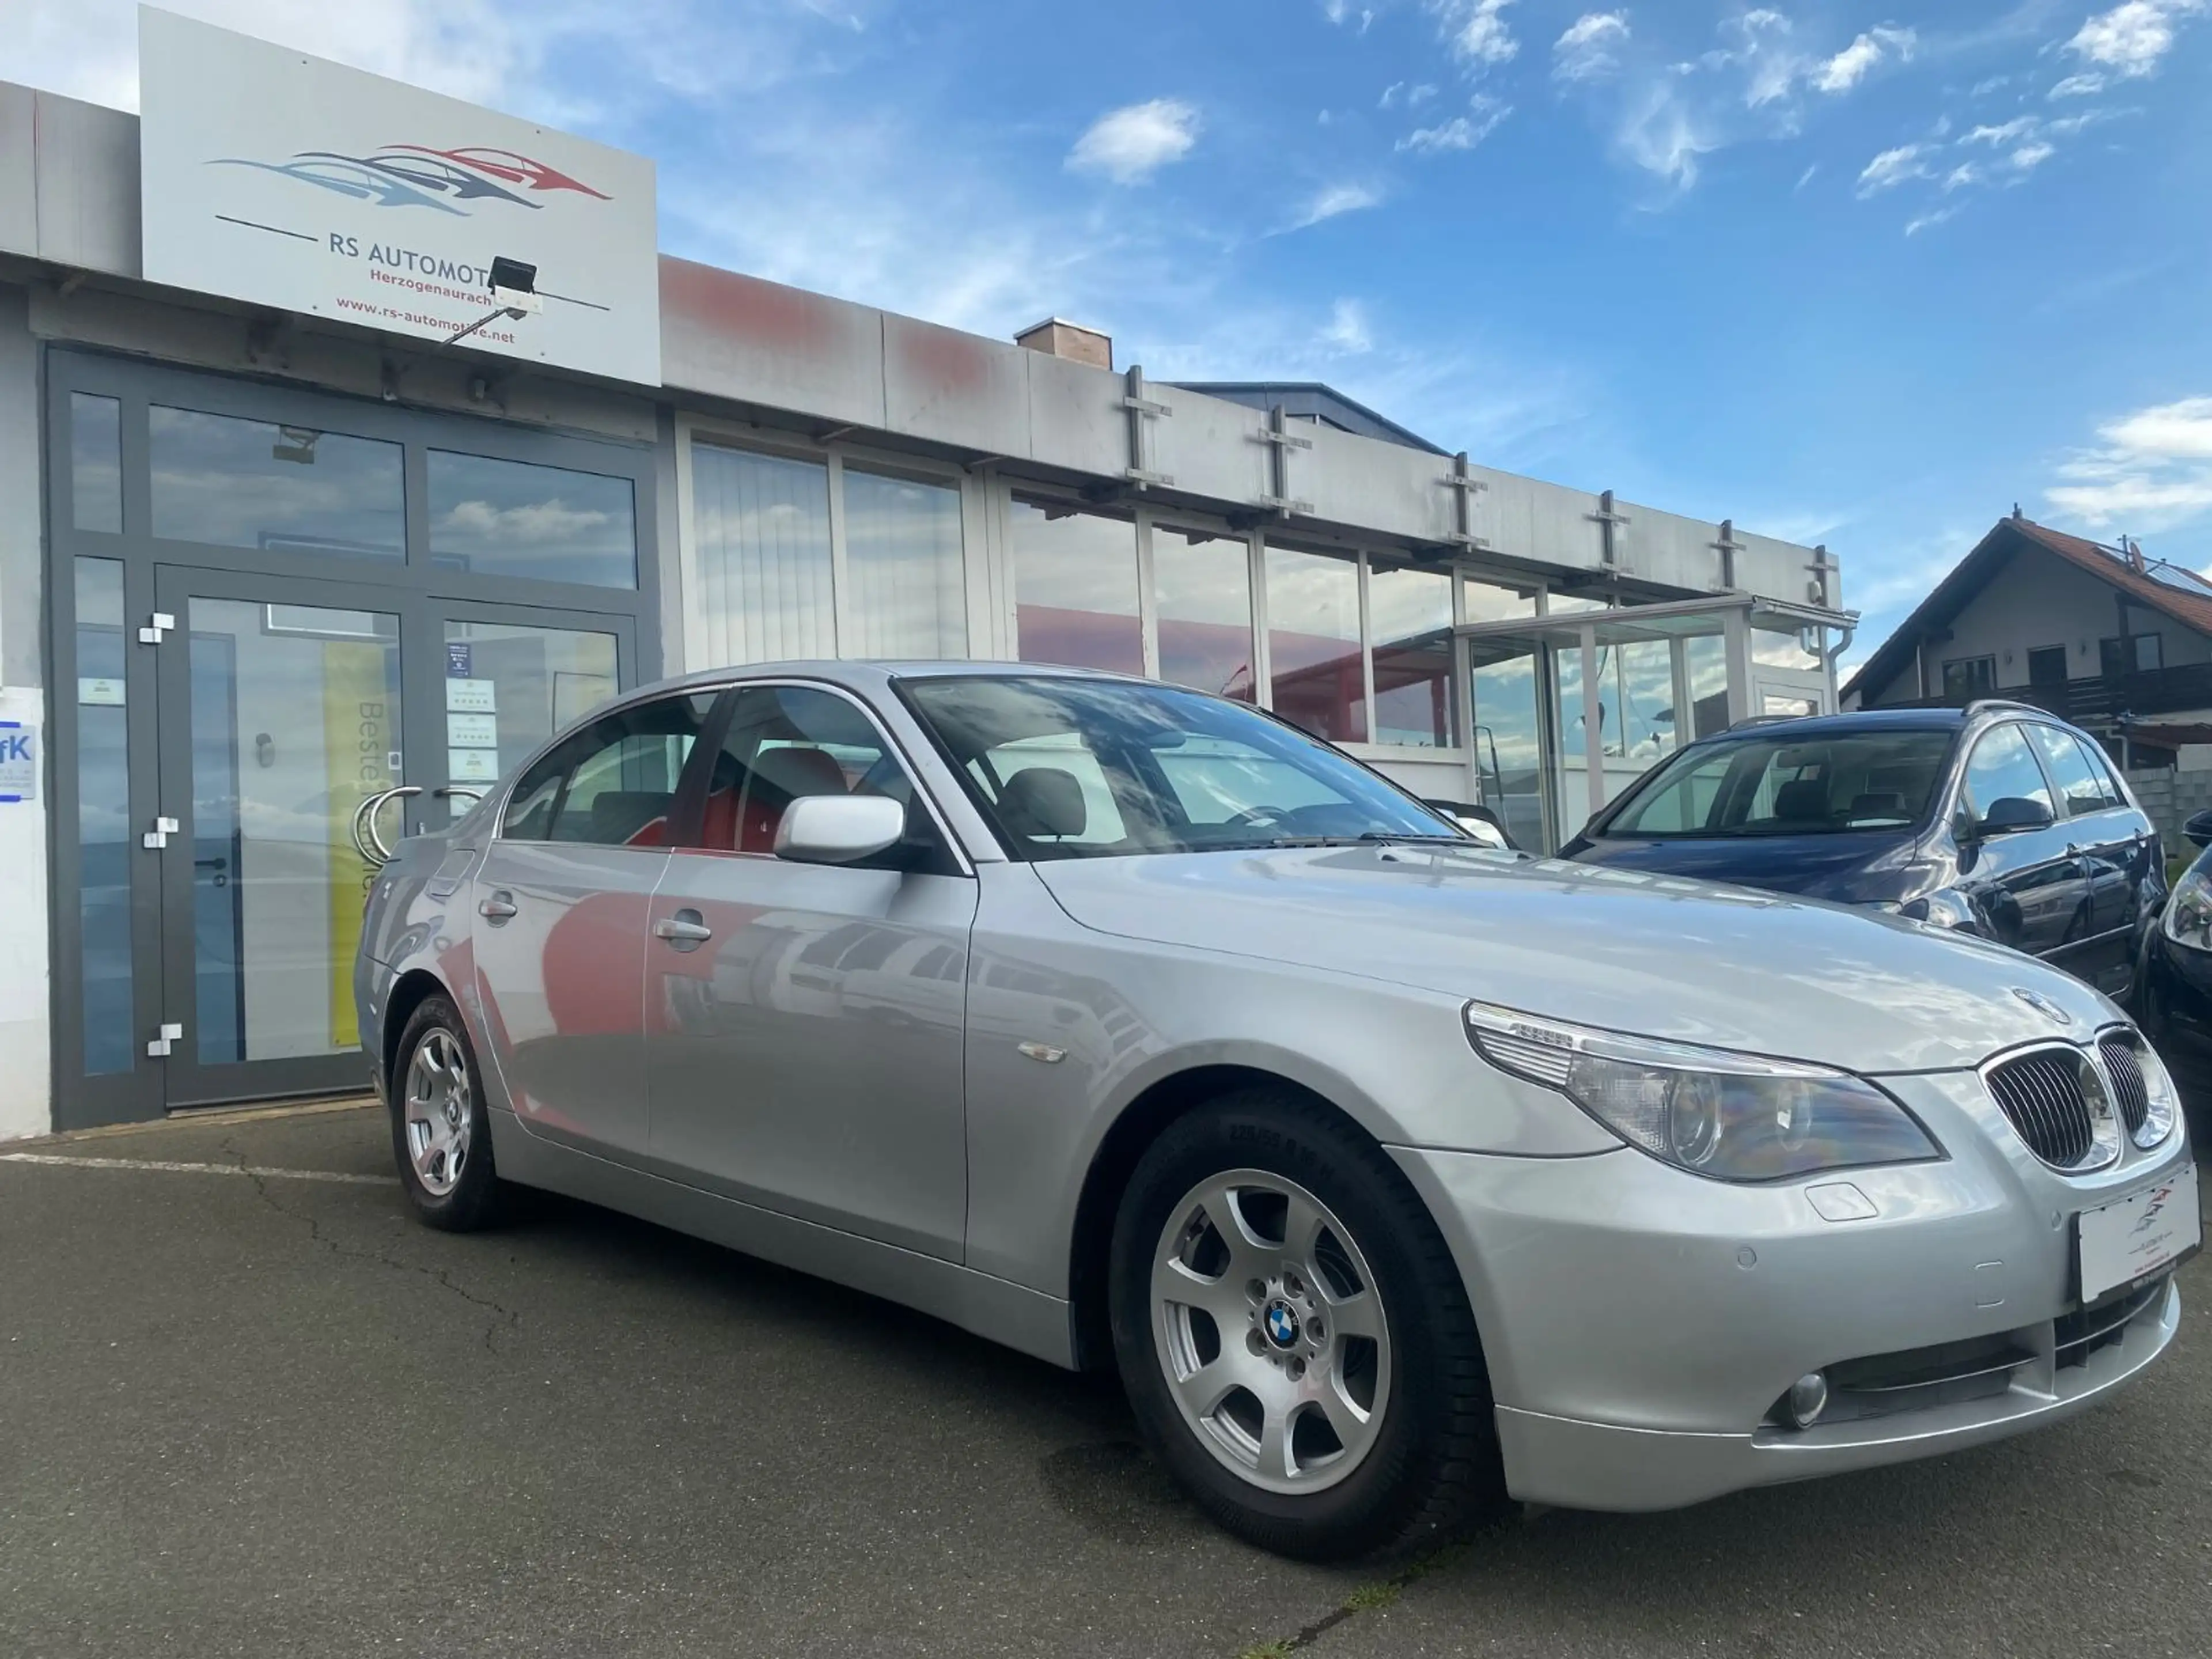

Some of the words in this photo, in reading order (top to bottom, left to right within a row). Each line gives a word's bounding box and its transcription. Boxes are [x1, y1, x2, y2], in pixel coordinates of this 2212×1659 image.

[329, 232, 359, 257] RS
[368, 243, 489, 287] AUTOMOT
[370, 268, 492, 306] Herzogenaurach
[336, 297, 515, 344] www.rs-automotve.net
[358, 702, 384, 781] Beste
